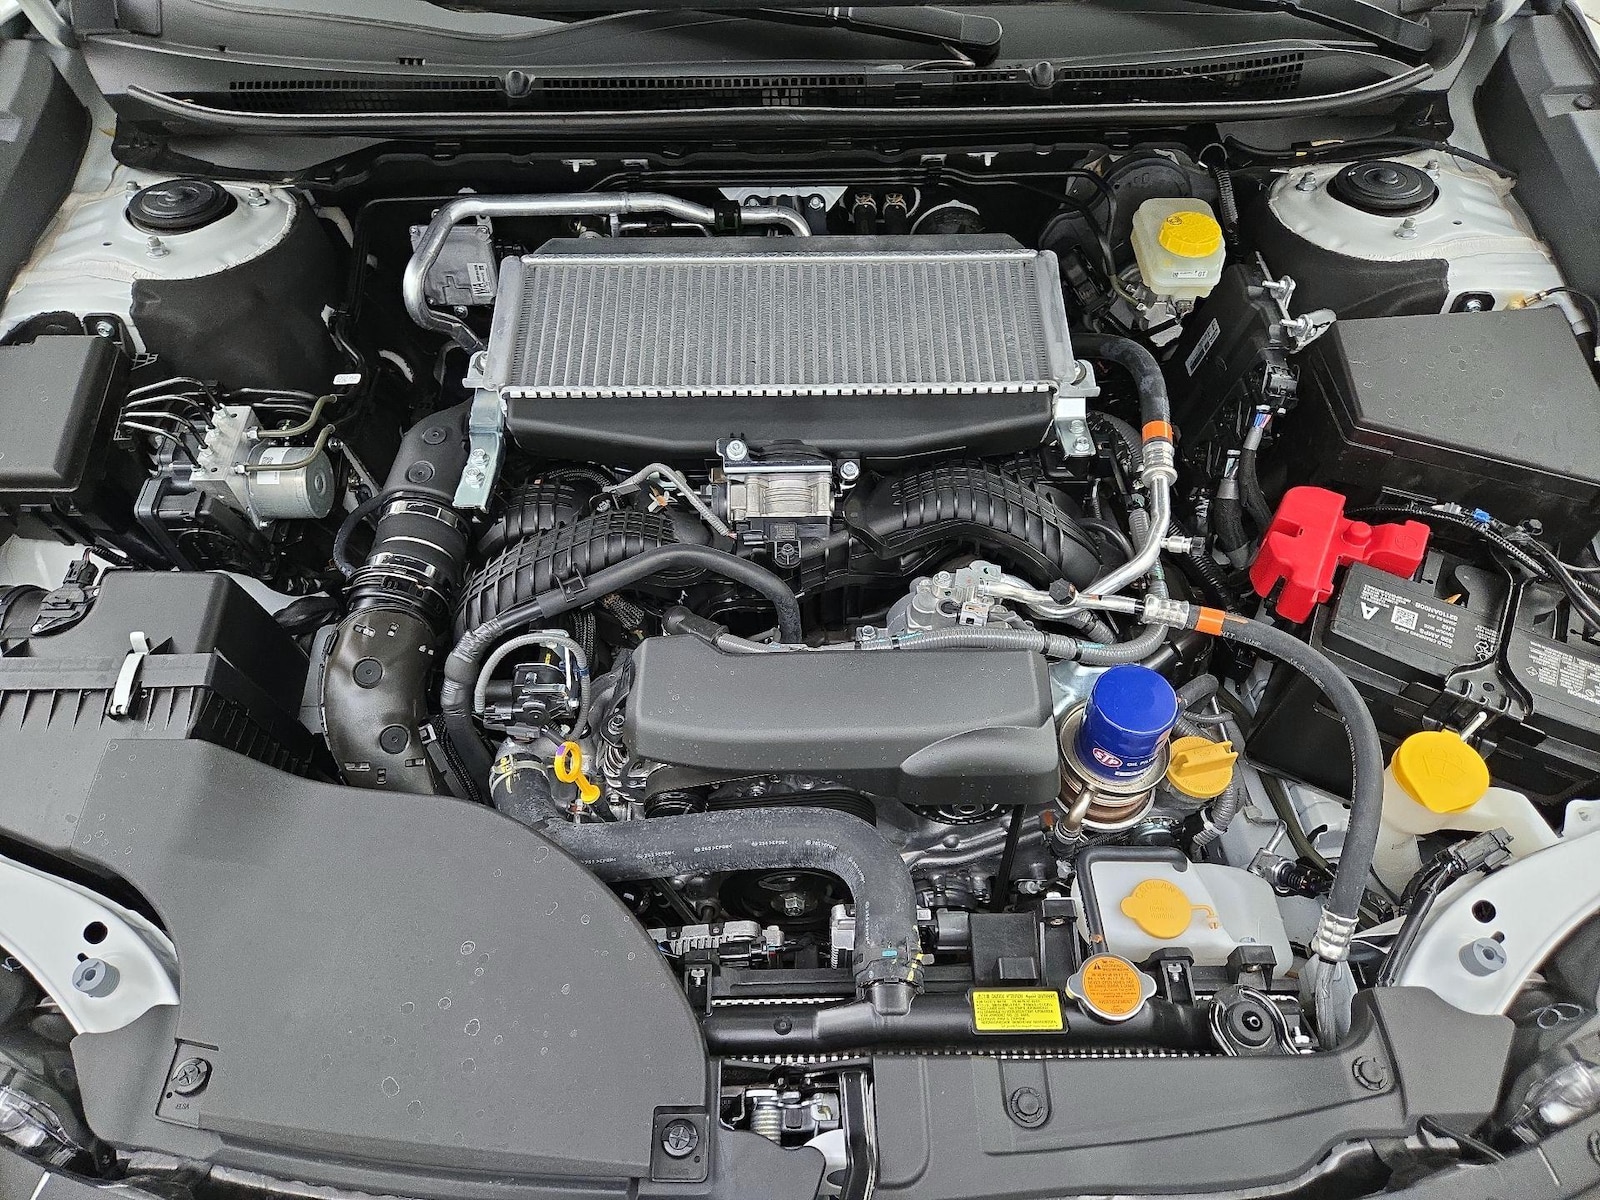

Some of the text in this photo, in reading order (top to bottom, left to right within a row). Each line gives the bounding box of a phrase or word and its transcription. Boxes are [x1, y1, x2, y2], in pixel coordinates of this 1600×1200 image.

[1360, 600, 1379, 620] A
[1418, 627, 1439, 639] AMPS
[1095, 750, 1119, 764] STP
